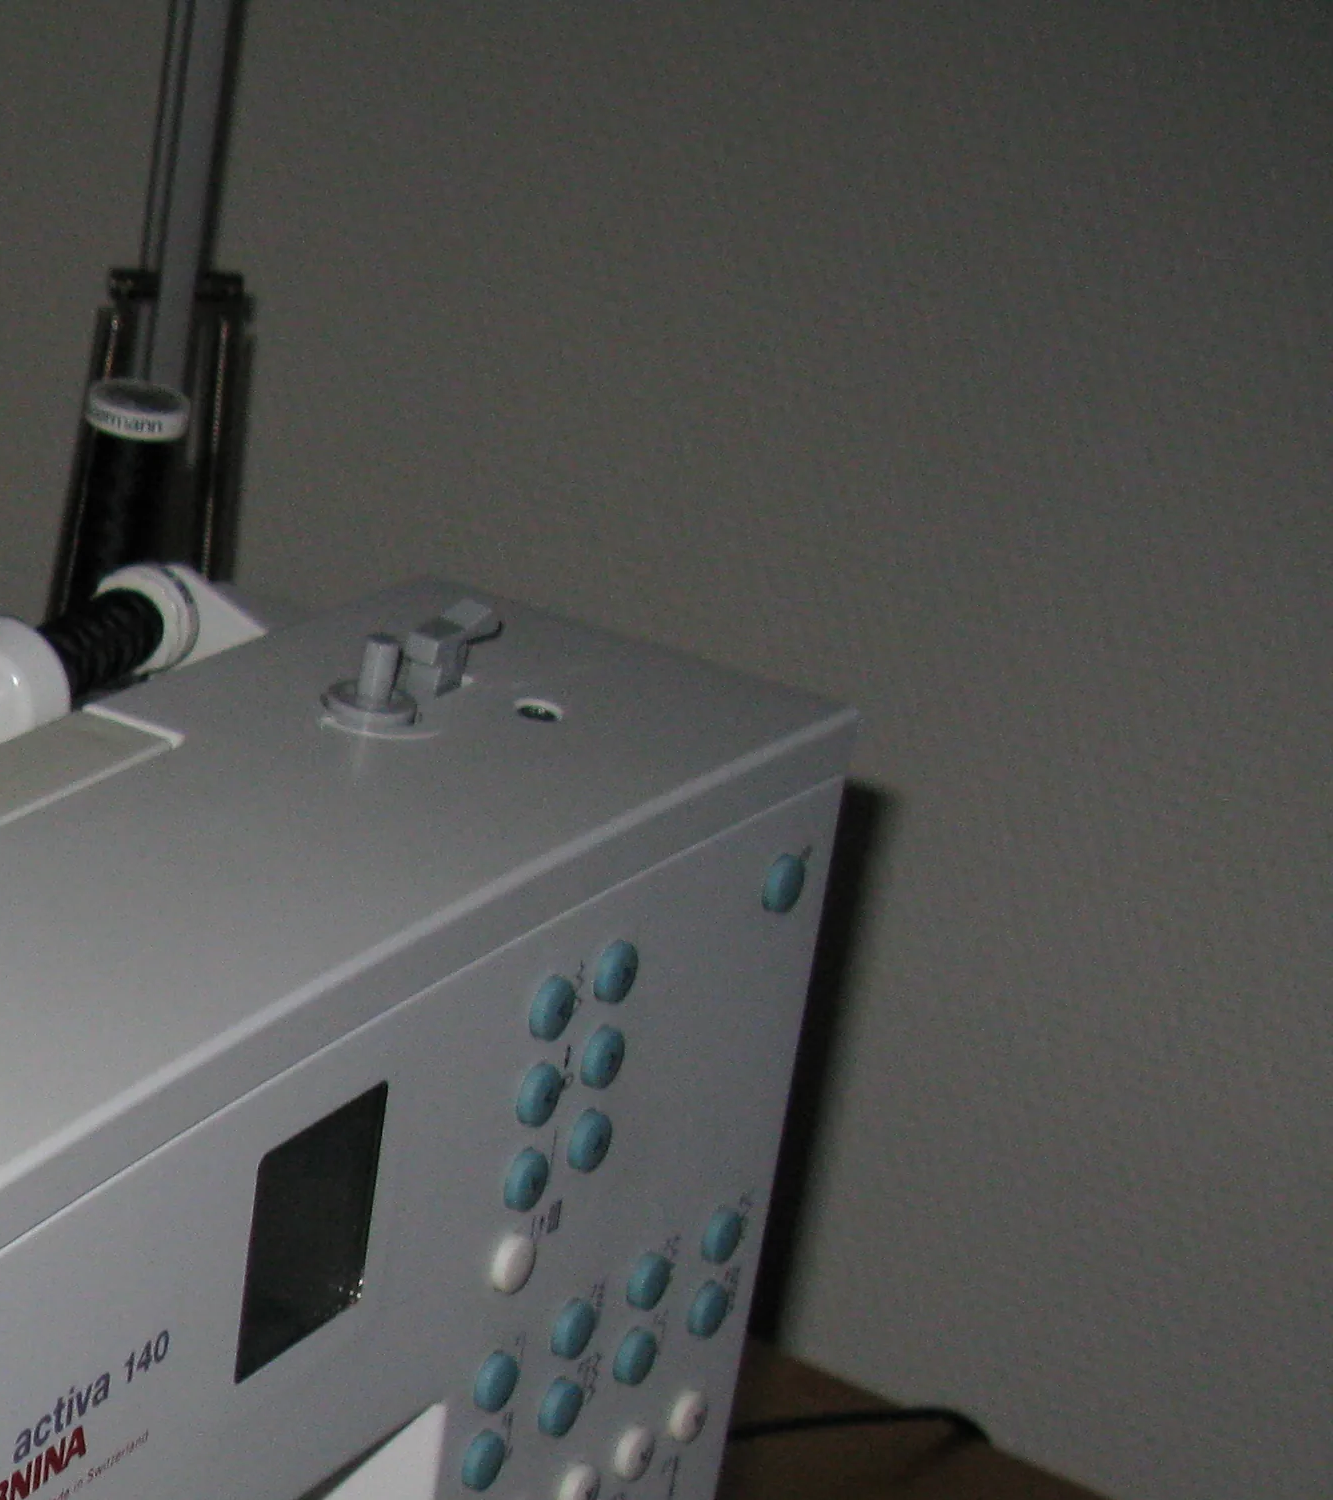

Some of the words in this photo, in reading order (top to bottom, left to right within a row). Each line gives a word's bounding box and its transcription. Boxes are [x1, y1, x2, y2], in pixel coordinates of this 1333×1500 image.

[13, 1371, 111, 1464] activa
[124, 1328, 171, 1384] 140
[71, 1478, 84, 1495] in
[86, 1429, 150, 1485] Switzerland
